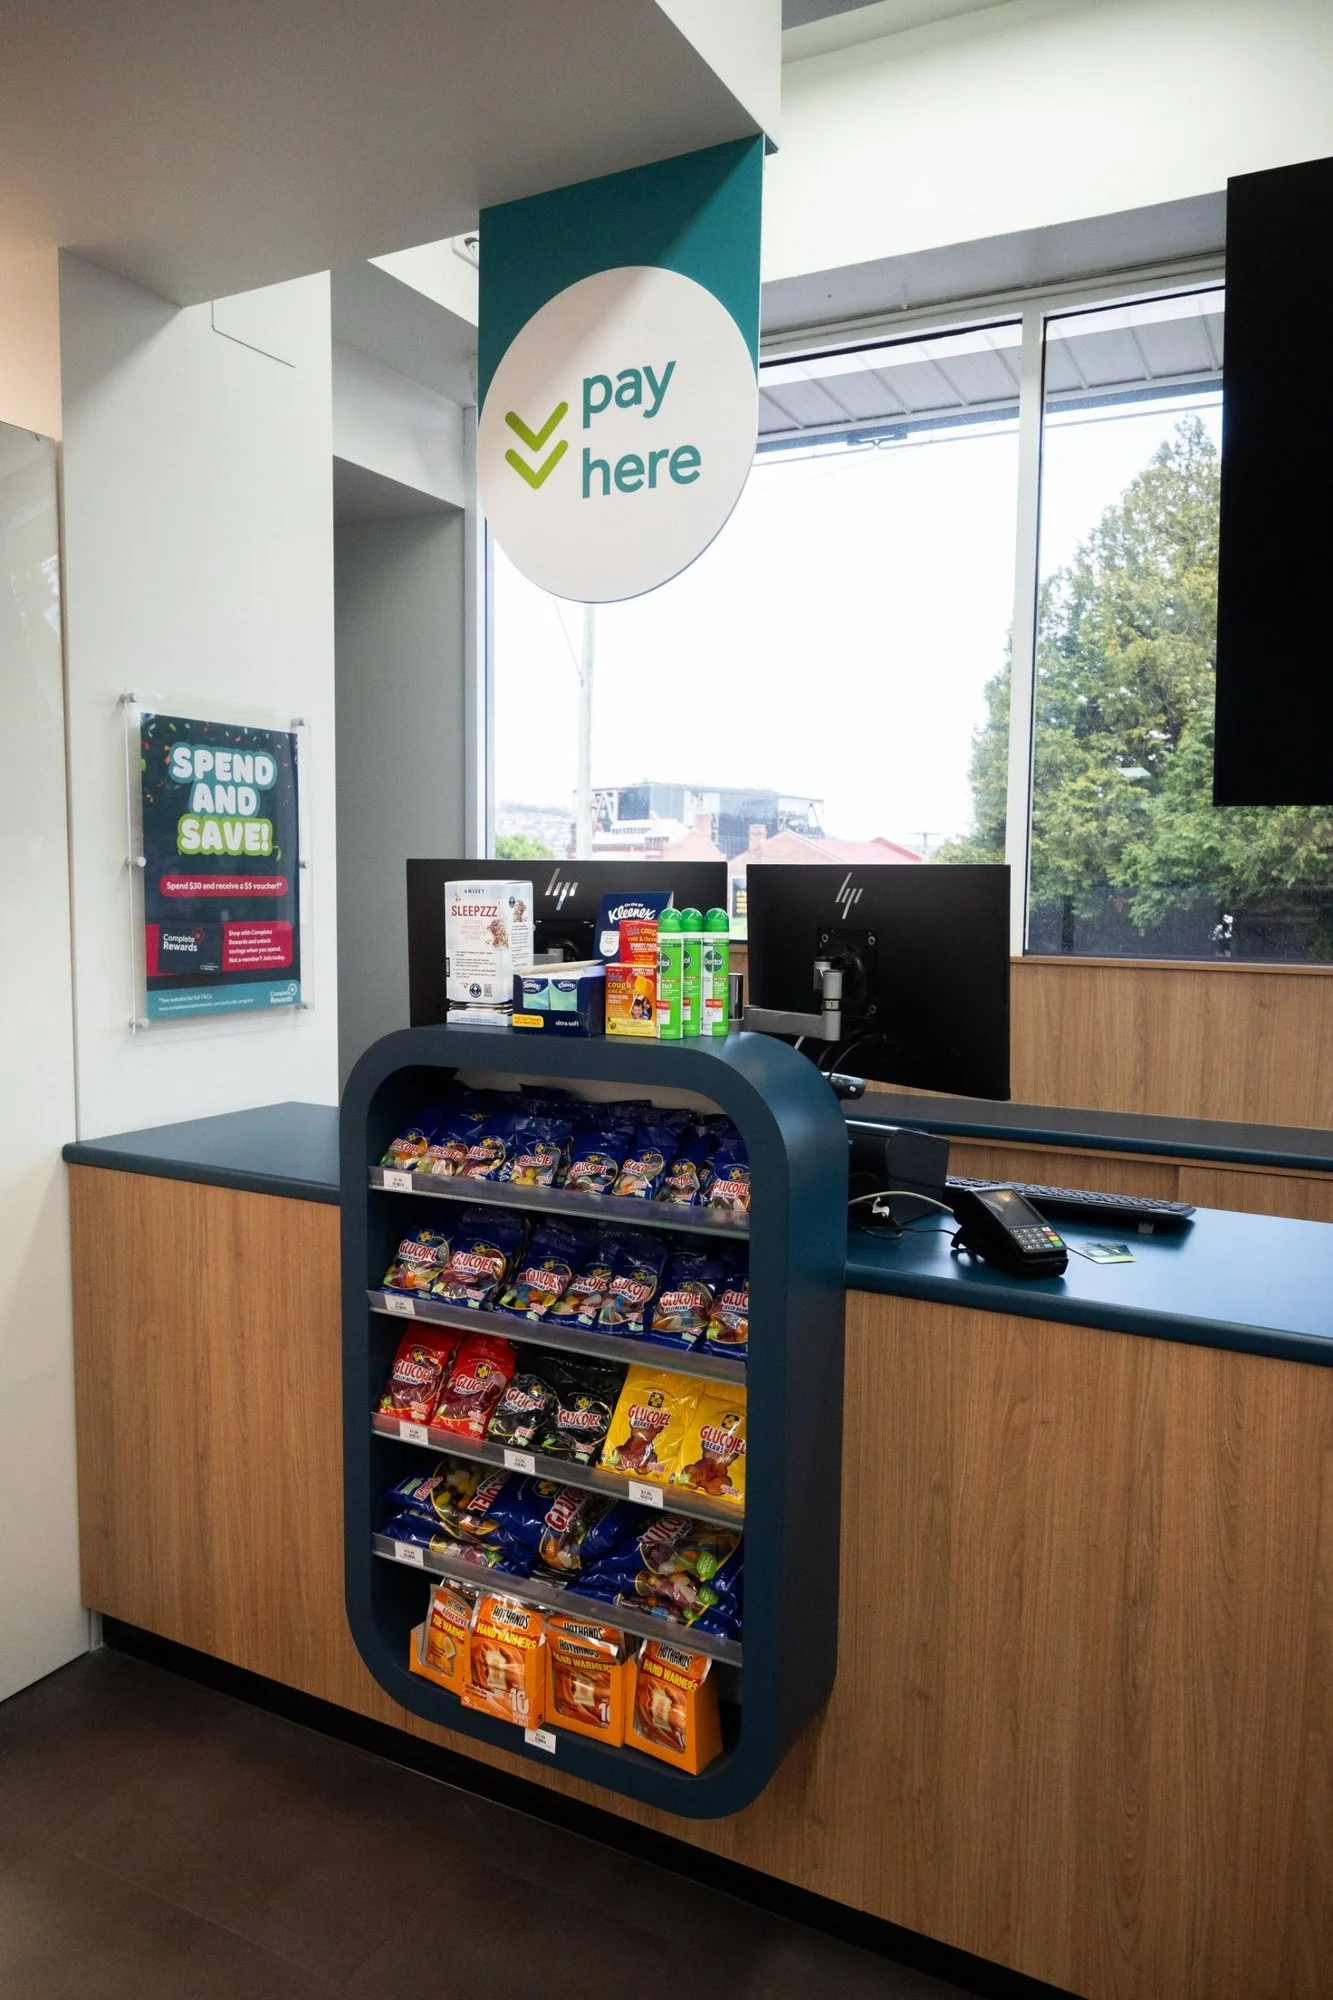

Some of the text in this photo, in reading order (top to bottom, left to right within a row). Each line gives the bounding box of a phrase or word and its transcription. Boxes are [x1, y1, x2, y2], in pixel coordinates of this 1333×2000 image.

[583, 361, 676, 428] pay
[582, 443, 701, 498] here
[173, 747, 274, 786] SPEND
[193, 783, 257, 816] AND
[181, 818, 270, 852] SAVE!
[166, 881, 188, 891] Spend
[189, 881, 201, 890] $30
[202, 882, 214, 890] and
[215, 882, 239, 890] receive
[245, 882, 252, 890] $5
[451, 905, 498, 917] SLEEPZZZ
[608, 905, 656, 923] Kleenex
[163, 933, 195, 944] Complete
[163, 941, 198, 952] Rewards
[400, 1240, 437, 1262] GLUCOJEL
[453, 1252, 493, 1272] GLUCOJEL
[662, 1292, 704, 1308] GLUCOJEL
[722, 1290, 749, 1307] GLUC
[558, 1410, 601, 1428] GLUCOJEL
[628, 1405, 671, 1426] GLUCOJEL
[633, 1420, 651, 1428] BEARS
[700, 1426, 746, 1454] GLUCOJEL
[705, 1440, 724, 1453] BEARS
[493, 1605, 530, 1630] HOTHANDS
[442, 1621, 465, 1640] WARME
[477, 1623, 537, 1649] HAND WARMERS
[558, 1639, 600, 1659] HOTHANDS
[657, 1643, 693, 1671] HOTHANDS
[644, 1659, 699, 1692] HAND WARMERS
